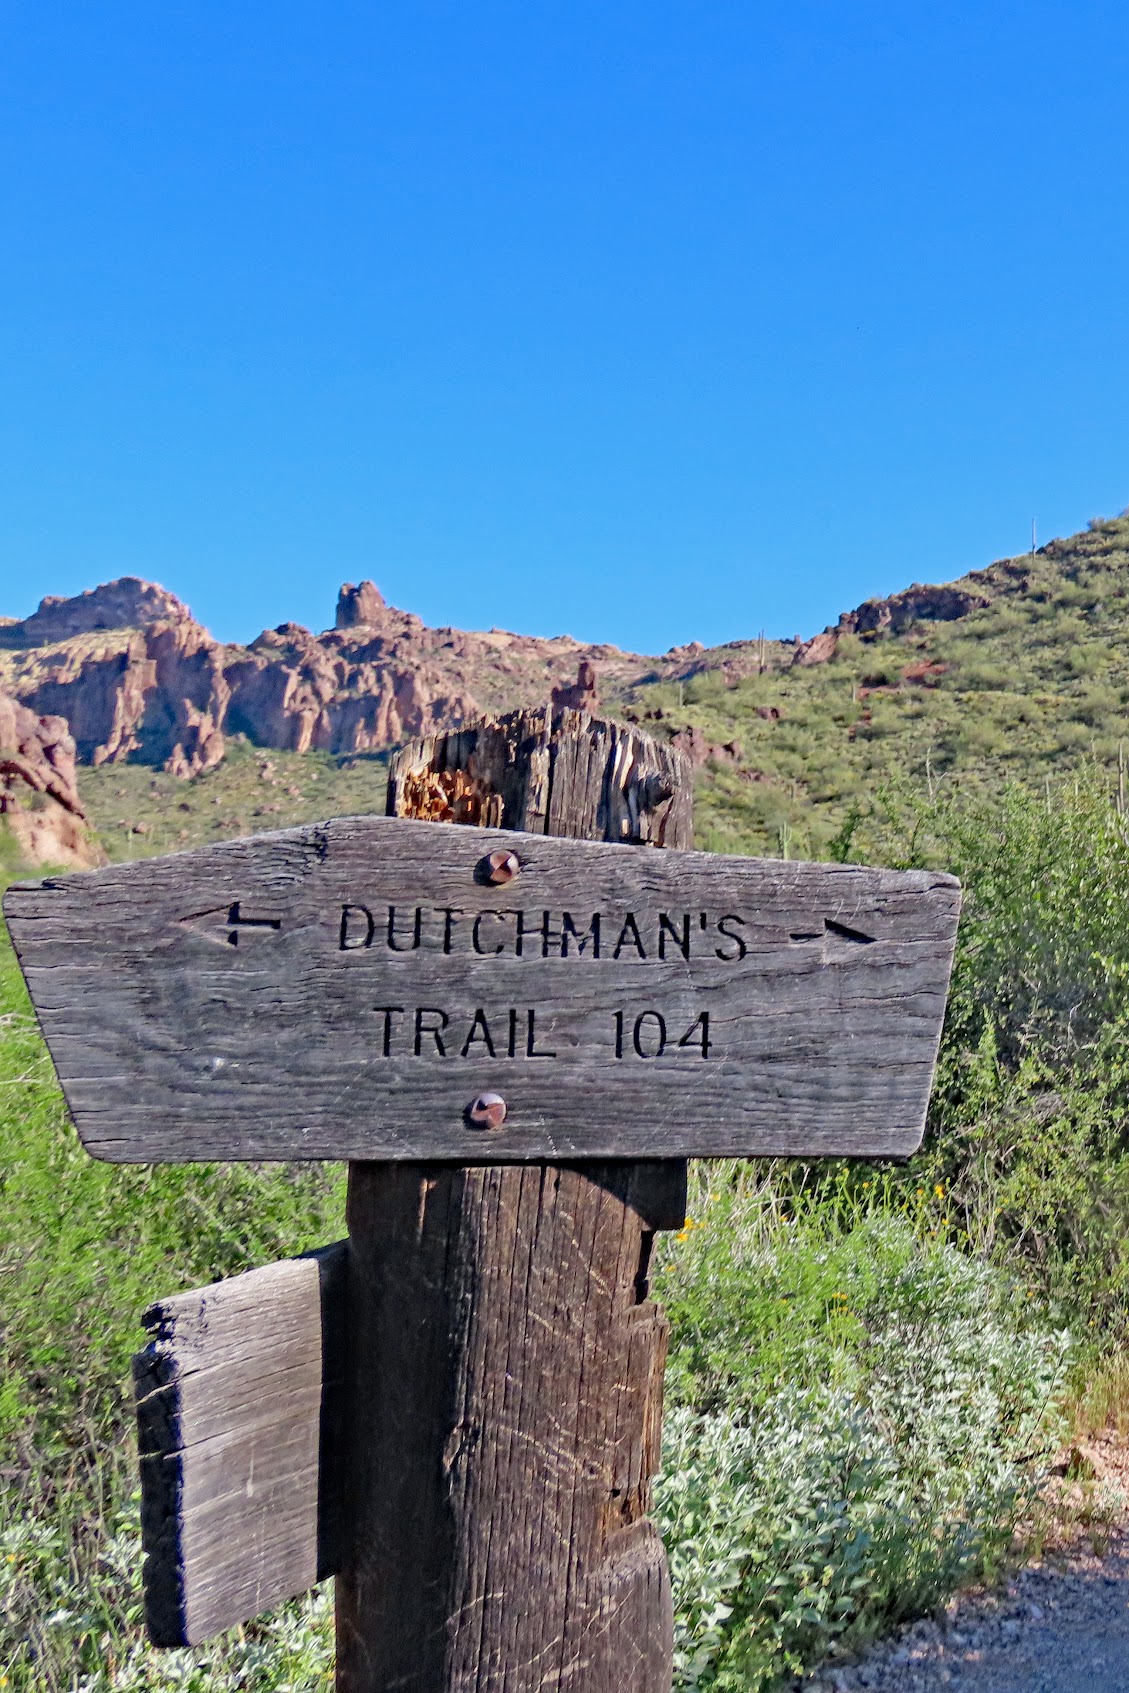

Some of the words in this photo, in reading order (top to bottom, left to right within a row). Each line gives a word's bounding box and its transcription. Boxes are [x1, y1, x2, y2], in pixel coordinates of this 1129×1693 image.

[340, 905, 747, 962] DUTCHMAN'S
[375, 1007, 557, 1058] TRAIL
[613, 1009, 713, 1060] 104
